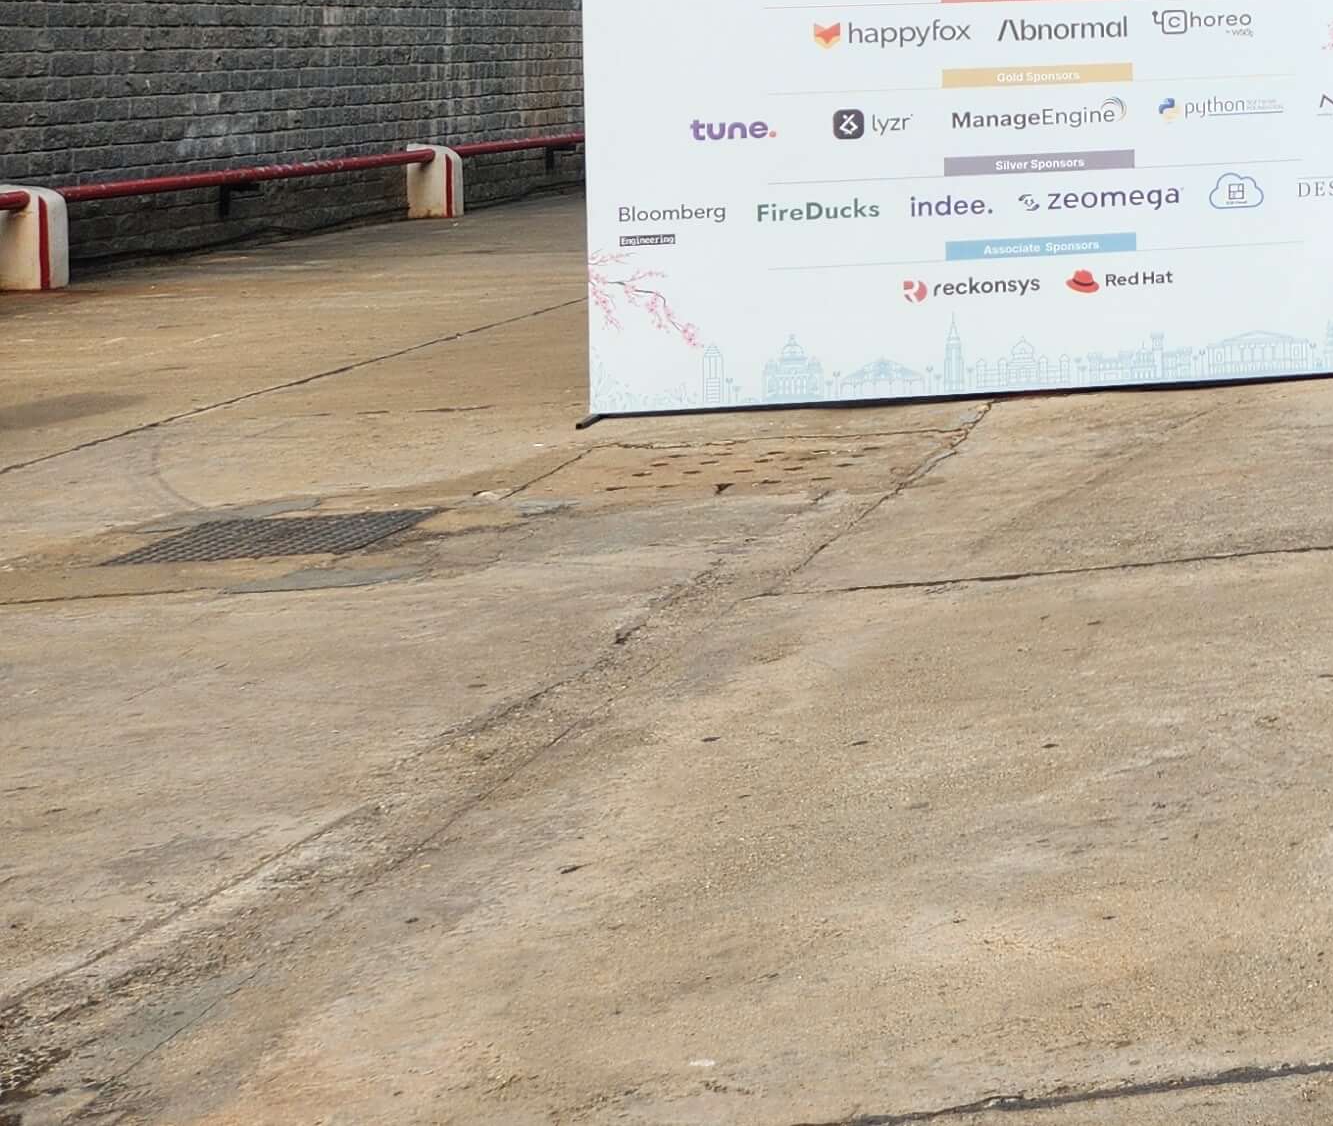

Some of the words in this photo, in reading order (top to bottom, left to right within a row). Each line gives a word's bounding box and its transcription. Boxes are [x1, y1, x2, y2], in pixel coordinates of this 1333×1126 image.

[848, 19, 971, 47] happyfox
[997, 16, 1127, 41] Abnormal
[997, 72, 1024, 83] Gold
[1026, 70, 1081, 83] Sponsors
[1184, 96, 1245, 118] python
[872, 114, 911, 135] lyzr
[951, 107, 1116, 130] ManageEngine
[995, 161, 1028, 171] Silver
[1030, 158, 1085, 171] Sponsors
[1047, 187, 1180, 211] zeomega
[618, 203, 726, 223] Bloomberg
[757, 198, 880, 222] FireDucks
[620, 235, 675, 246] Engineering
[983, 243, 1040, 255] Associate
[1046, 240, 1100, 253] Sponsors
[933, 277, 1041, 297] reckonsys
[1105, 272, 1139, 287] Red
[1143, 270, 1174, 285] Hat
